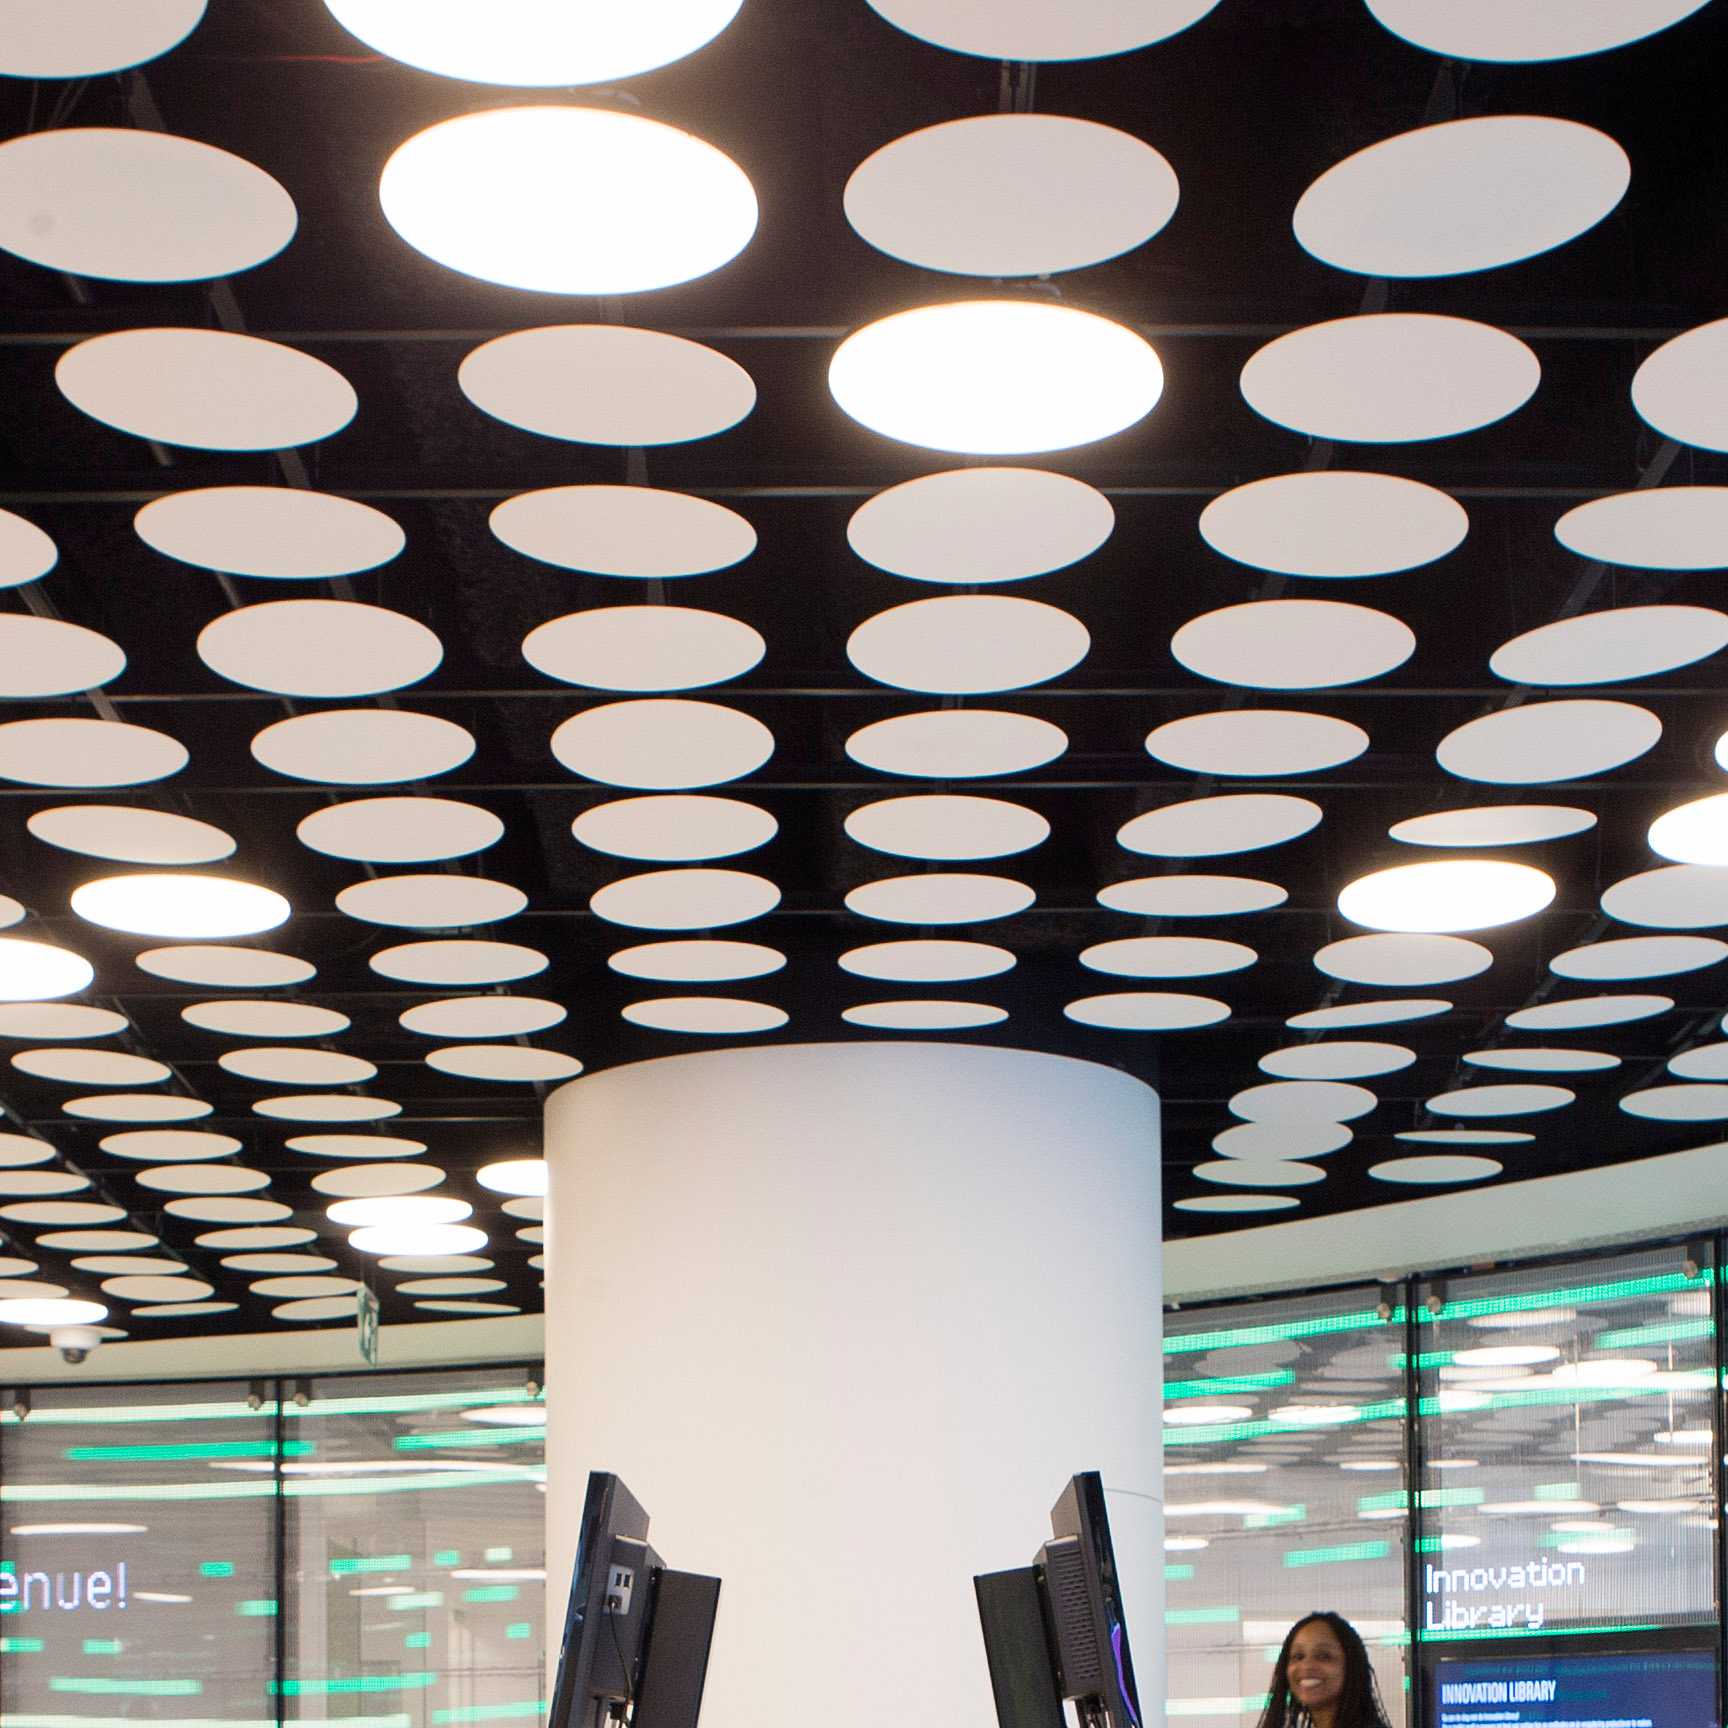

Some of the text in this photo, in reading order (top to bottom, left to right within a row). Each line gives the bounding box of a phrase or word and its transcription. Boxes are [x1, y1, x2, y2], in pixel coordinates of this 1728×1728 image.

[1426, 1556, 1585, 1594] Innovation
[1426, 1600, 1544, 1631] Library
[1442, 1679, 1557, 1705] INNOVATION LIBRARY
